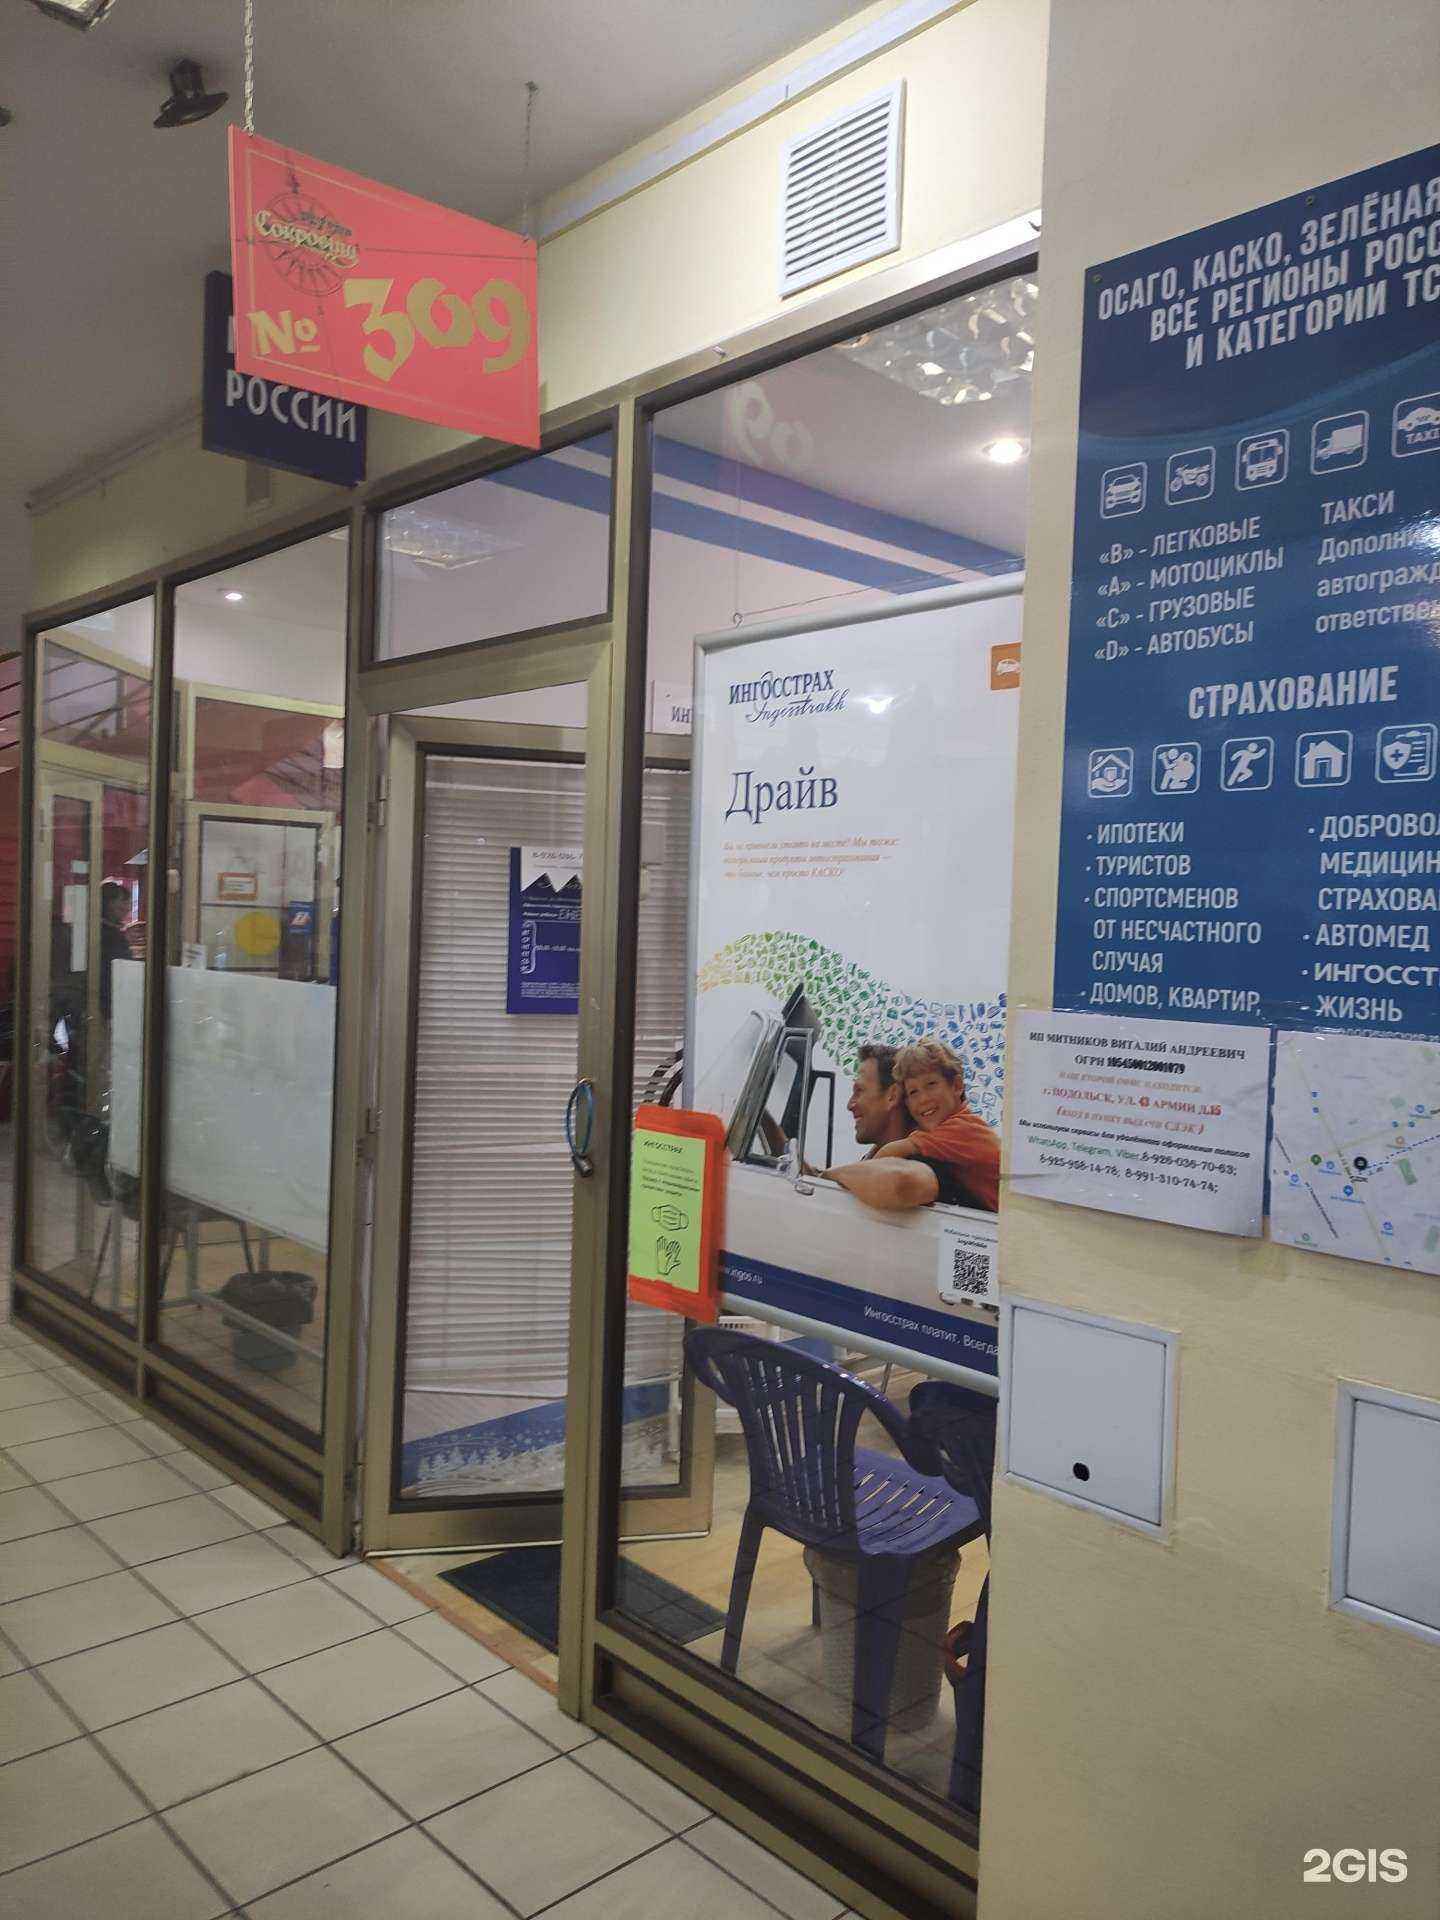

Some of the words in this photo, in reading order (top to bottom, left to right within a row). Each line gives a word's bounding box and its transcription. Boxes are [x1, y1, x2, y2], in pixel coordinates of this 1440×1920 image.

[1098, 267, 1185, 321] ОСАГО,
[1192, 231, 1293, 292] КАСКО,
[1300, 176, 1440, 256] ЗЕЛЁНАЯ
[1149, 297, 1200, 343] ВСЕ
[1211, 249, 1351, 325] РЕГИОНЫ
[343, 276, 533, 383] 309
[1185, 333, 1205, 370] И
[1215, 279, 1388, 362] КАТЕГОРИИ
[225, 368, 357, 443] РОССИИ
[1320, 490, 1396, 526] ТАКСИ
[1150, 516, 1262, 558] ЛЕГКОВЫЕ
[1149, 547, 1285, 590] МОТОЦИКЛЫ
[1148, 586, 1256, 623] ГРУЗОВЫЕ
[1147, 621, 1255, 656] АВТОБУСЫ
[728, 669, 835, 706] ИНГОССТРАХ
[1187, 665, 1400, 720] СТРАХОВАНИЕ
[723, 766, 840, 826] Драйв
[1096, 821, 1185, 846] ИПОТЕКИ
[1319, 812, 1440, 842] ДОБРОВО
[1095, 853, 1192, 876] ТУРИСТОВ
[1319, 849, 1440, 879] МЕДИЦИН
[1093, 887, 1239, 910] СПОРТСМЕНОВ
[1318, 887, 1440, 912] СТРАХОВА
[1092, 918, 1118, 940] ОТ
[1121, 919, 1263, 945] НЕСЧАСТНОГО
[1314, 922, 1431, 953] АВТОМЕД
[1091, 950, 1164, 973] СЛУЧАЯ
[1313, 963, 1440, 988] ИНГОССТ
[1089, 981, 1161, 1010] ДОМОВ,
[1168, 986, 1262, 1017] КВАРТИР,
[1316, 994, 1403, 1023] ЖИЗНЬ
[1110, 1038, 1168, 1053] ВИТАЛИЙ
[1170, 1044, 1246, 1060] АНДРЕЕВИЧ
[1153, 1100, 1196, 1113] АРМИИ
[864, 1304, 920, 1333] Ингосстрах
[921, 1324, 961, 1344] платит.
